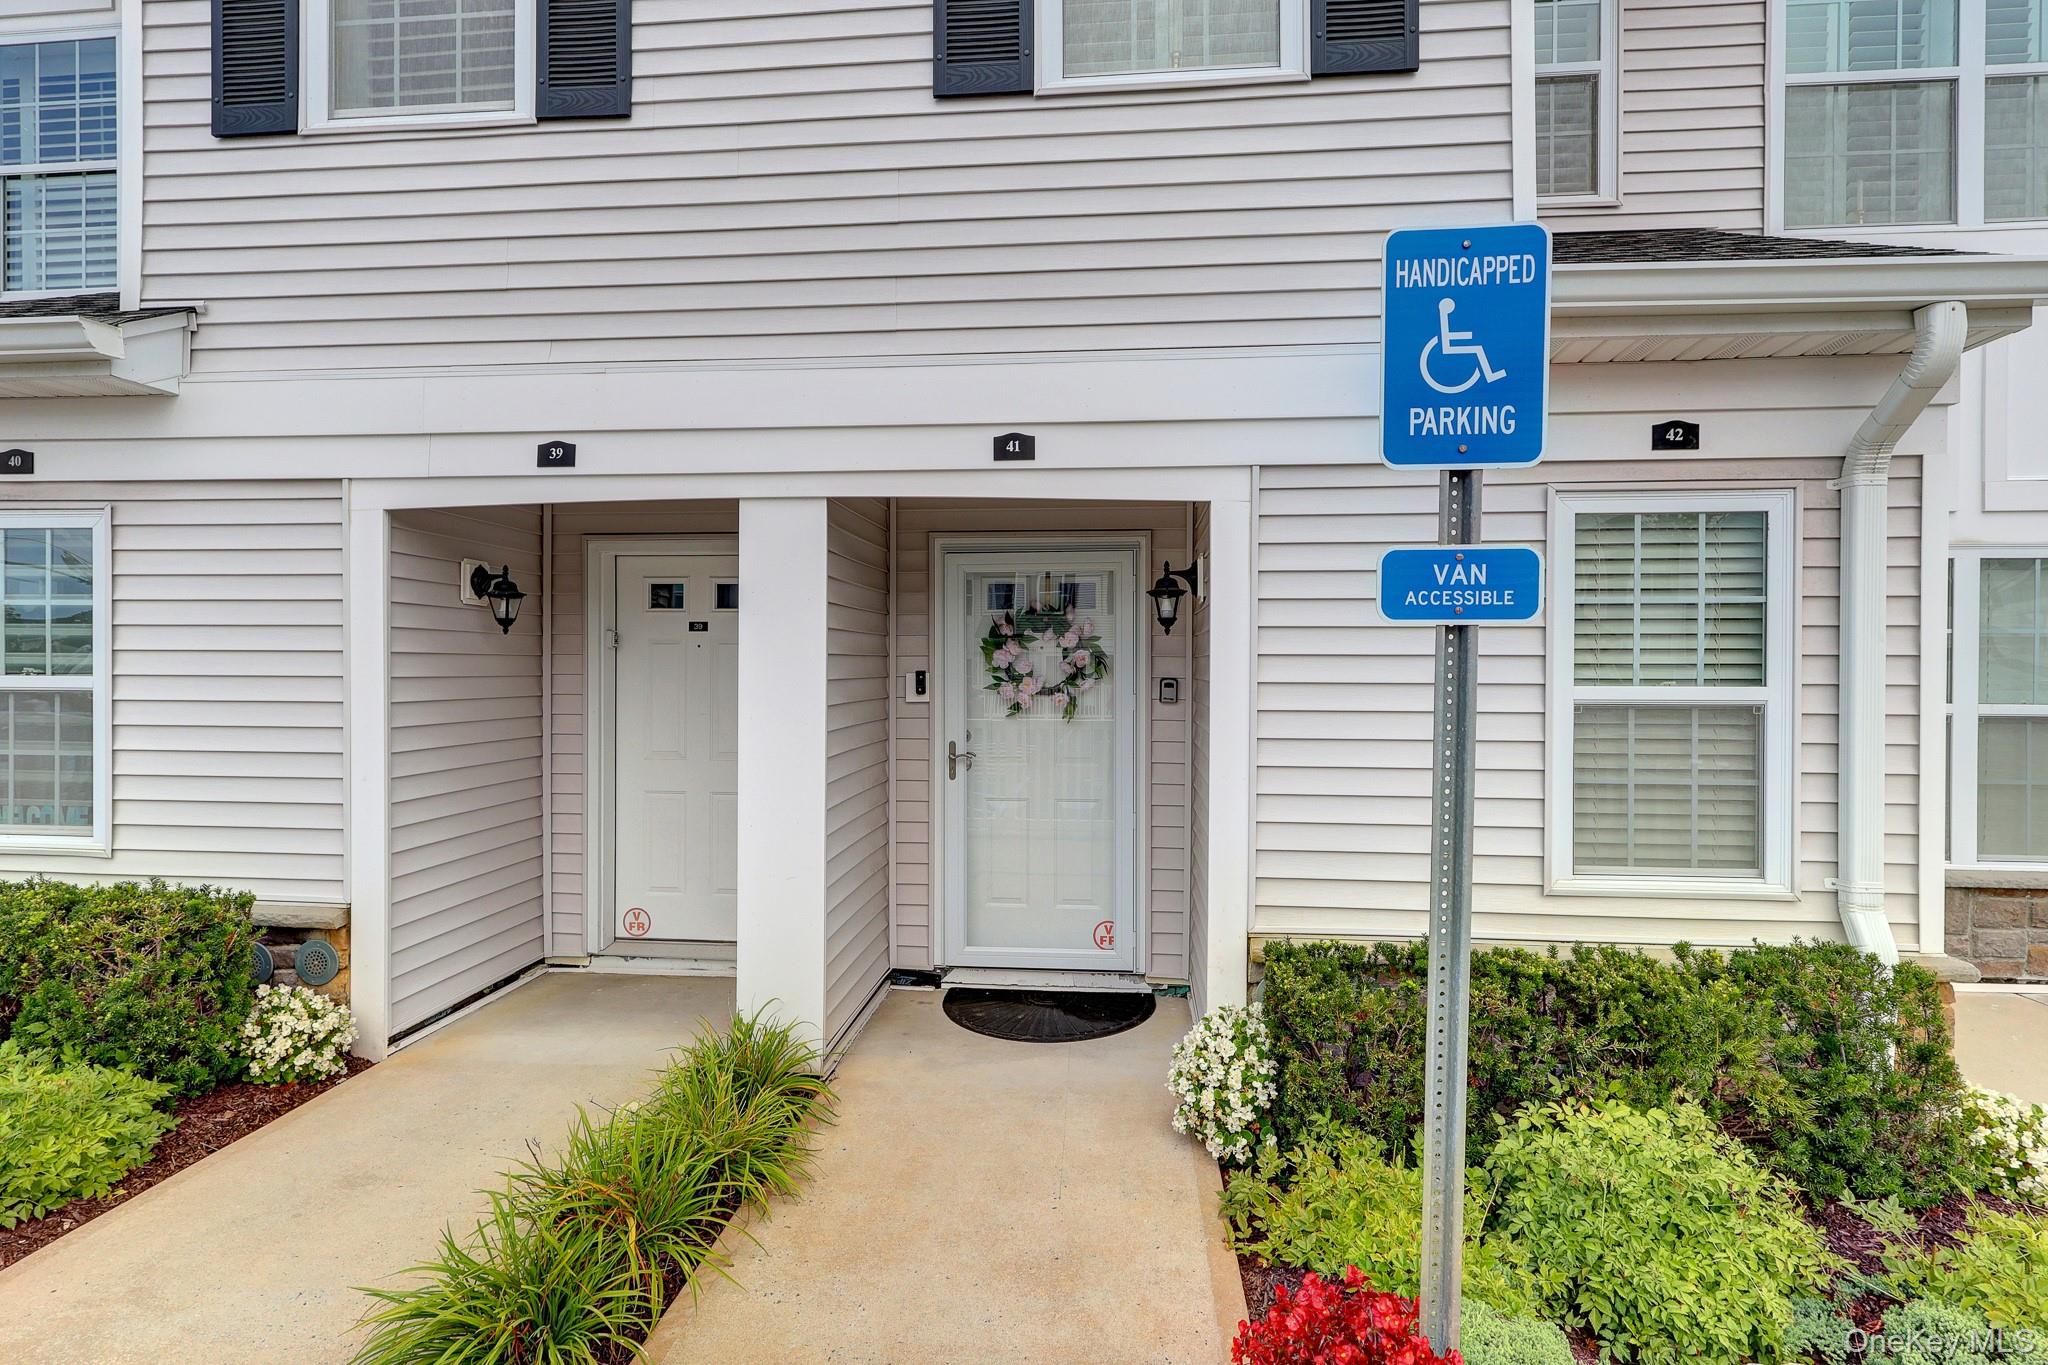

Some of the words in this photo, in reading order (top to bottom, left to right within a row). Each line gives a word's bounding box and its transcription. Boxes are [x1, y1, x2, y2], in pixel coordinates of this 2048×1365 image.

[1395, 254, 1536, 288] HANDICAPPED
[1409, 405, 1516, 436] PARKING
[1665, 428, 1684, 441] 42
[1005, 440, 1020, 452] 41
[549, 447, 563, 459] 39
[8, 455, 21, 467] 40
[1433, 563, 1487, 586] VAN
[1404, 590, 1515, 606] ACCESSIBLE
[632, 911, 641, 921] V
[629, 921, 645, 931] FR
[1103, 925, 1114, 935] V
